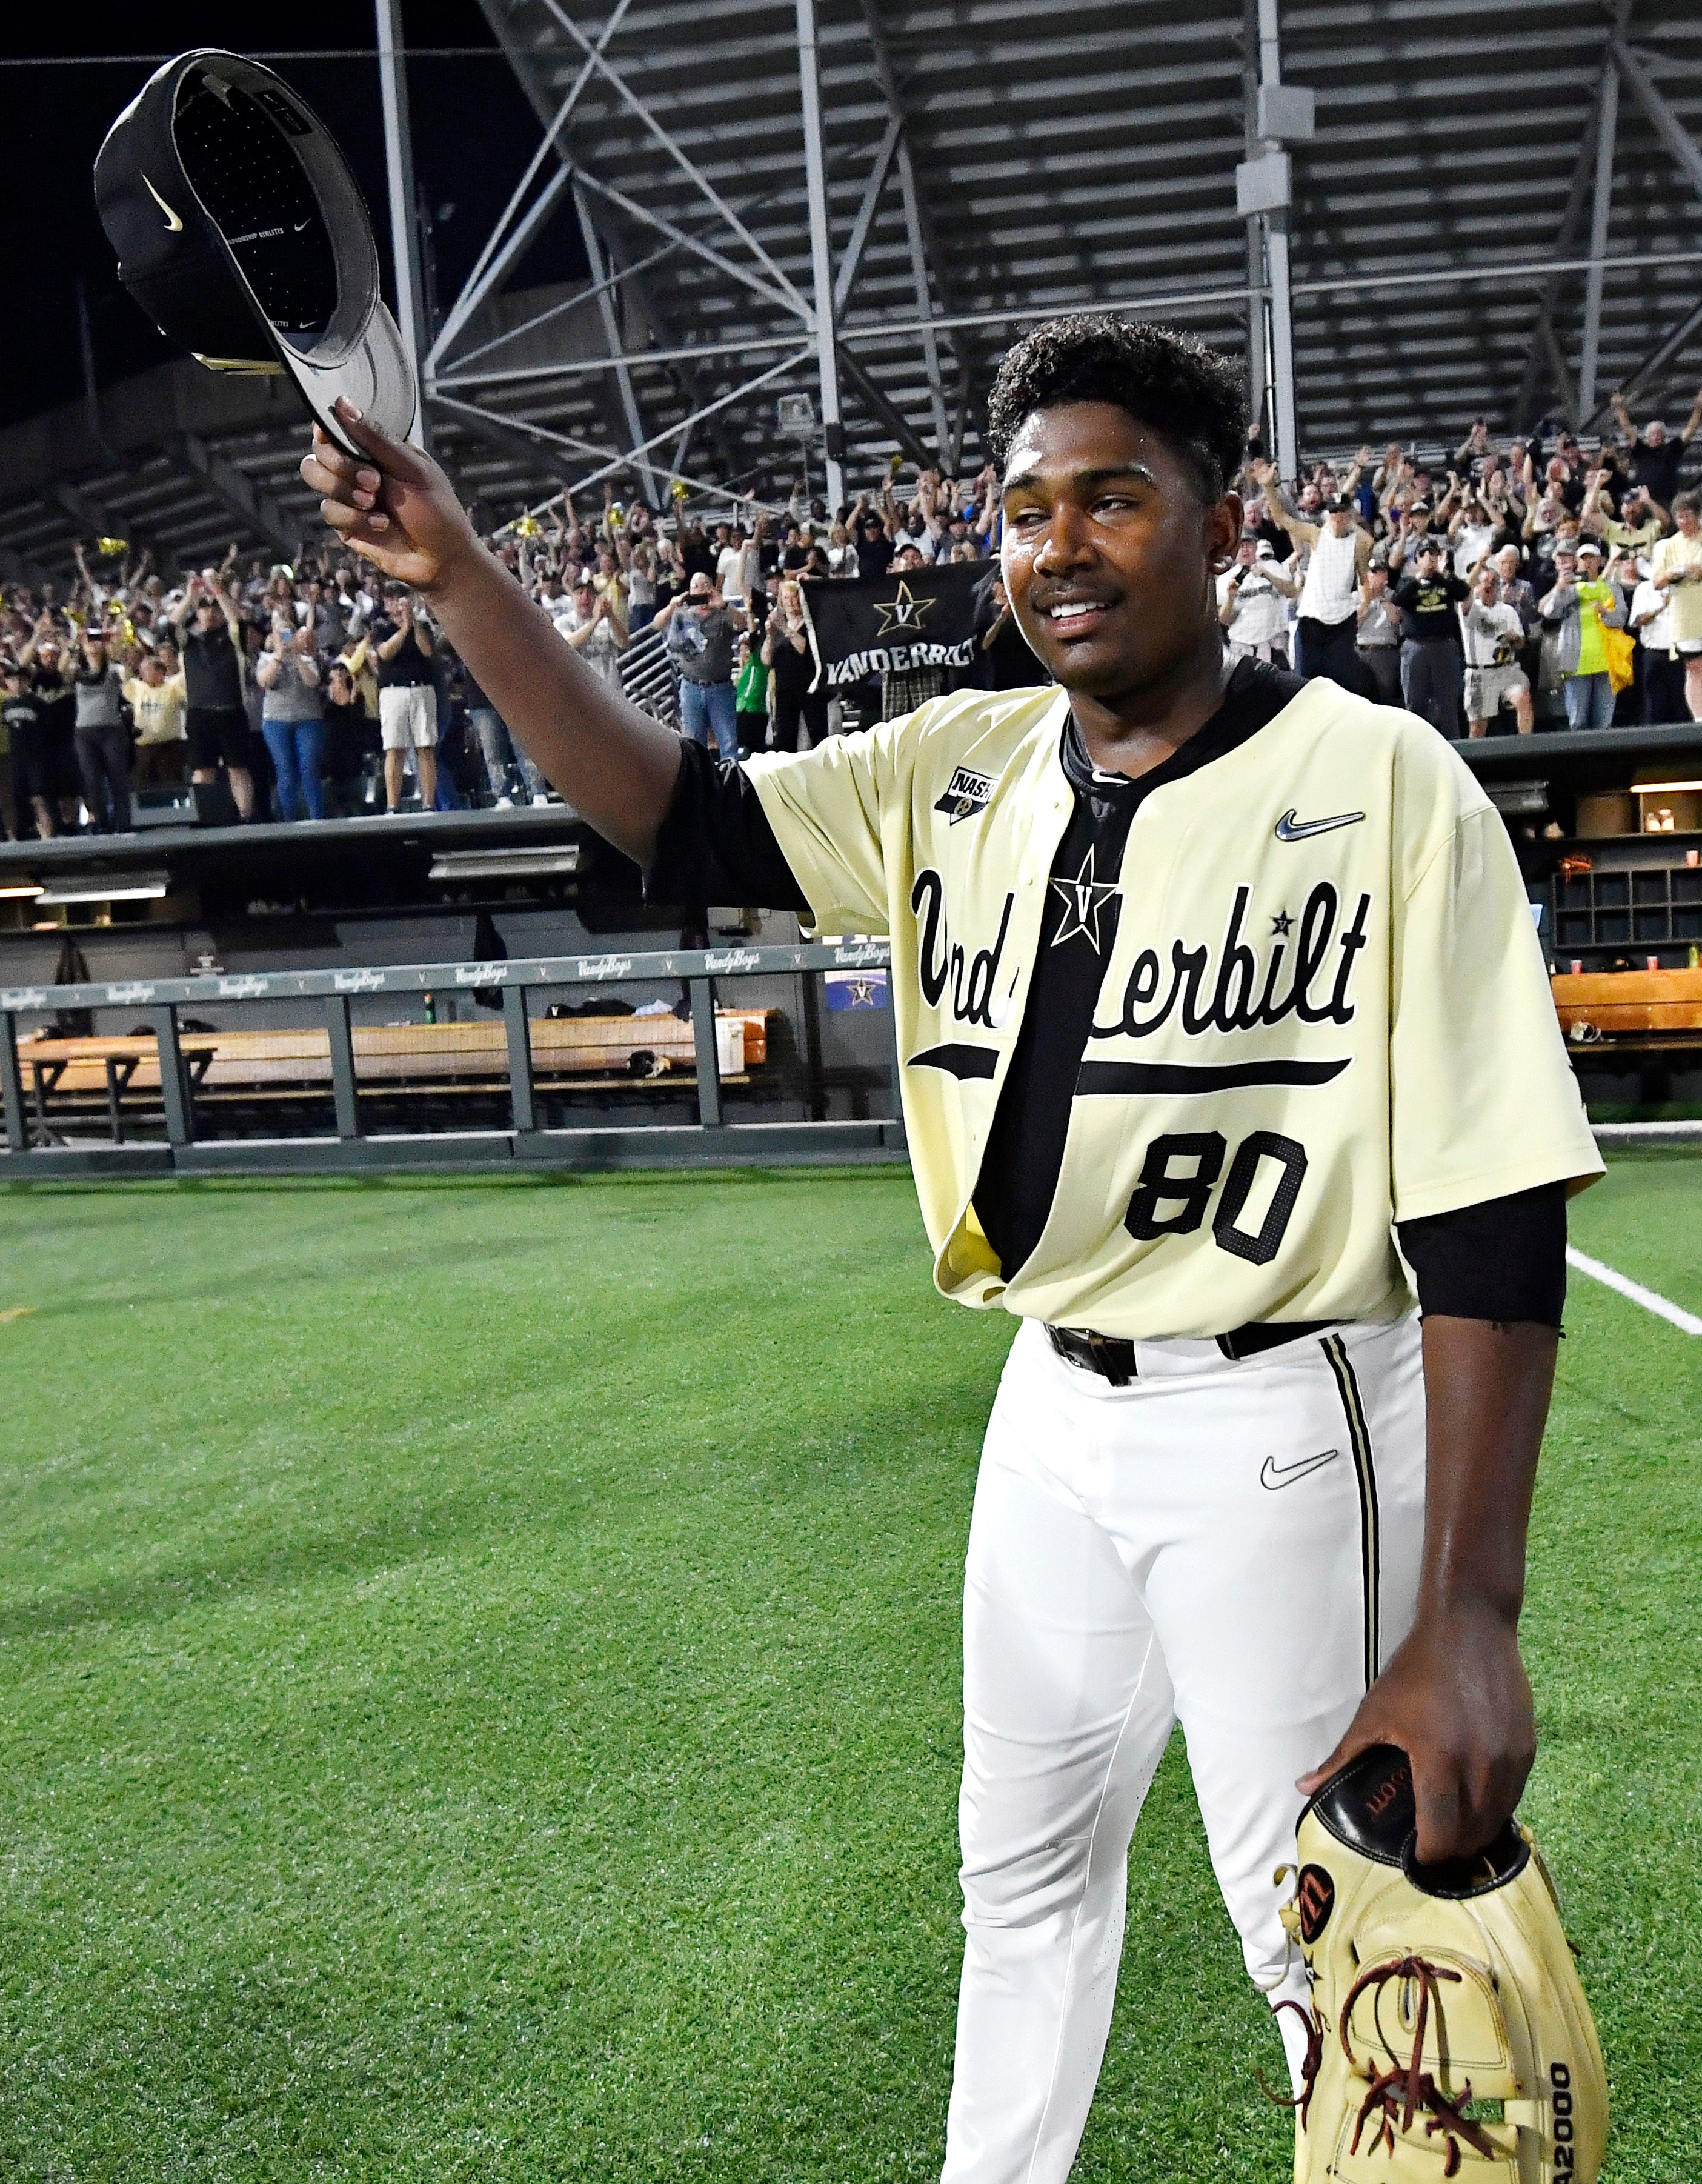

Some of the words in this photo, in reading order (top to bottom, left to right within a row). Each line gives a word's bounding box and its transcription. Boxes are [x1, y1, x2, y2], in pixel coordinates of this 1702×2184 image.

[895, 604, 913, 623] V
[1075, 885, 1092, 923] V
[578, 957, 631, 980] VandyBoys
[704, 950, 759, 974] VandyBoys
[857, 986, 866, 997] V
[1123, 1130, 1308, 1267] 80
